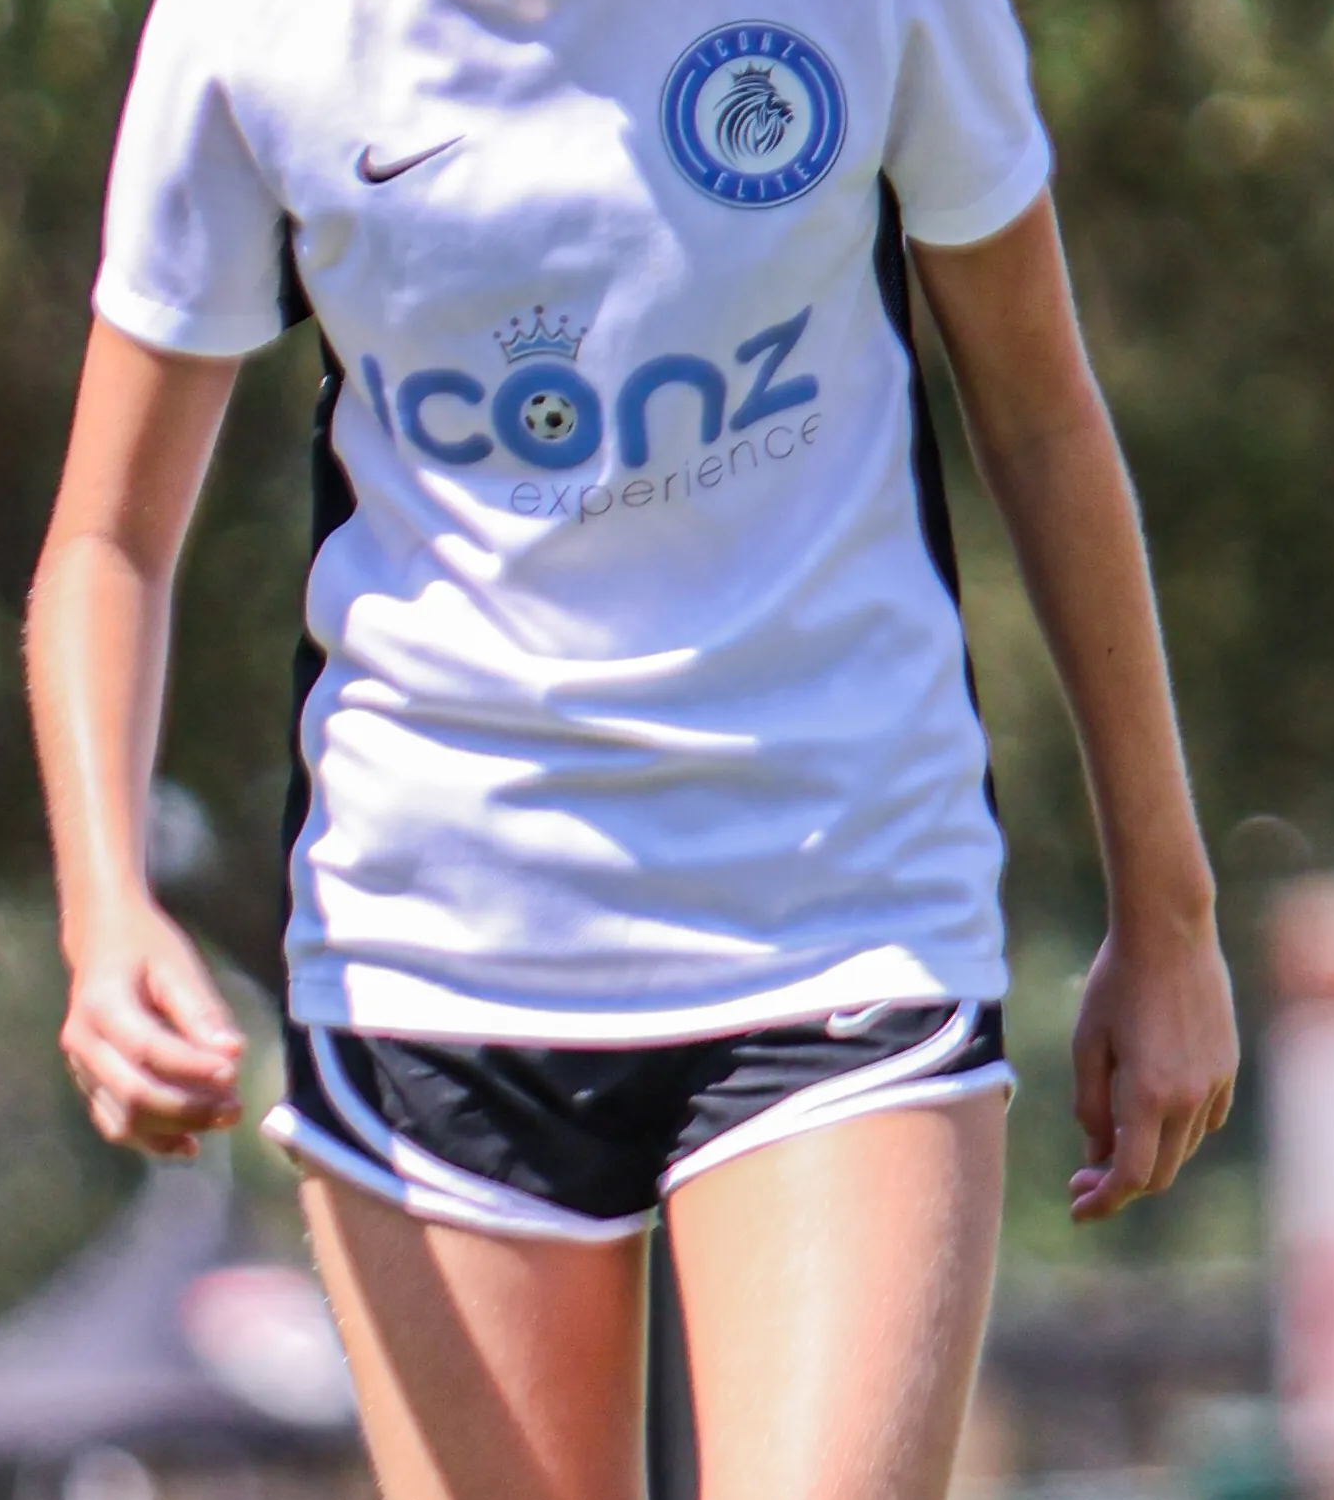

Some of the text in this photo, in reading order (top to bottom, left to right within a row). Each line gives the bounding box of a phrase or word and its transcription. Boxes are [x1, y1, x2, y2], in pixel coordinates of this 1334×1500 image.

[696, 30, 797, 68] ICONZ
[713, 162, 811, 199] ELITE
[509, 413, 823, 525] experience
